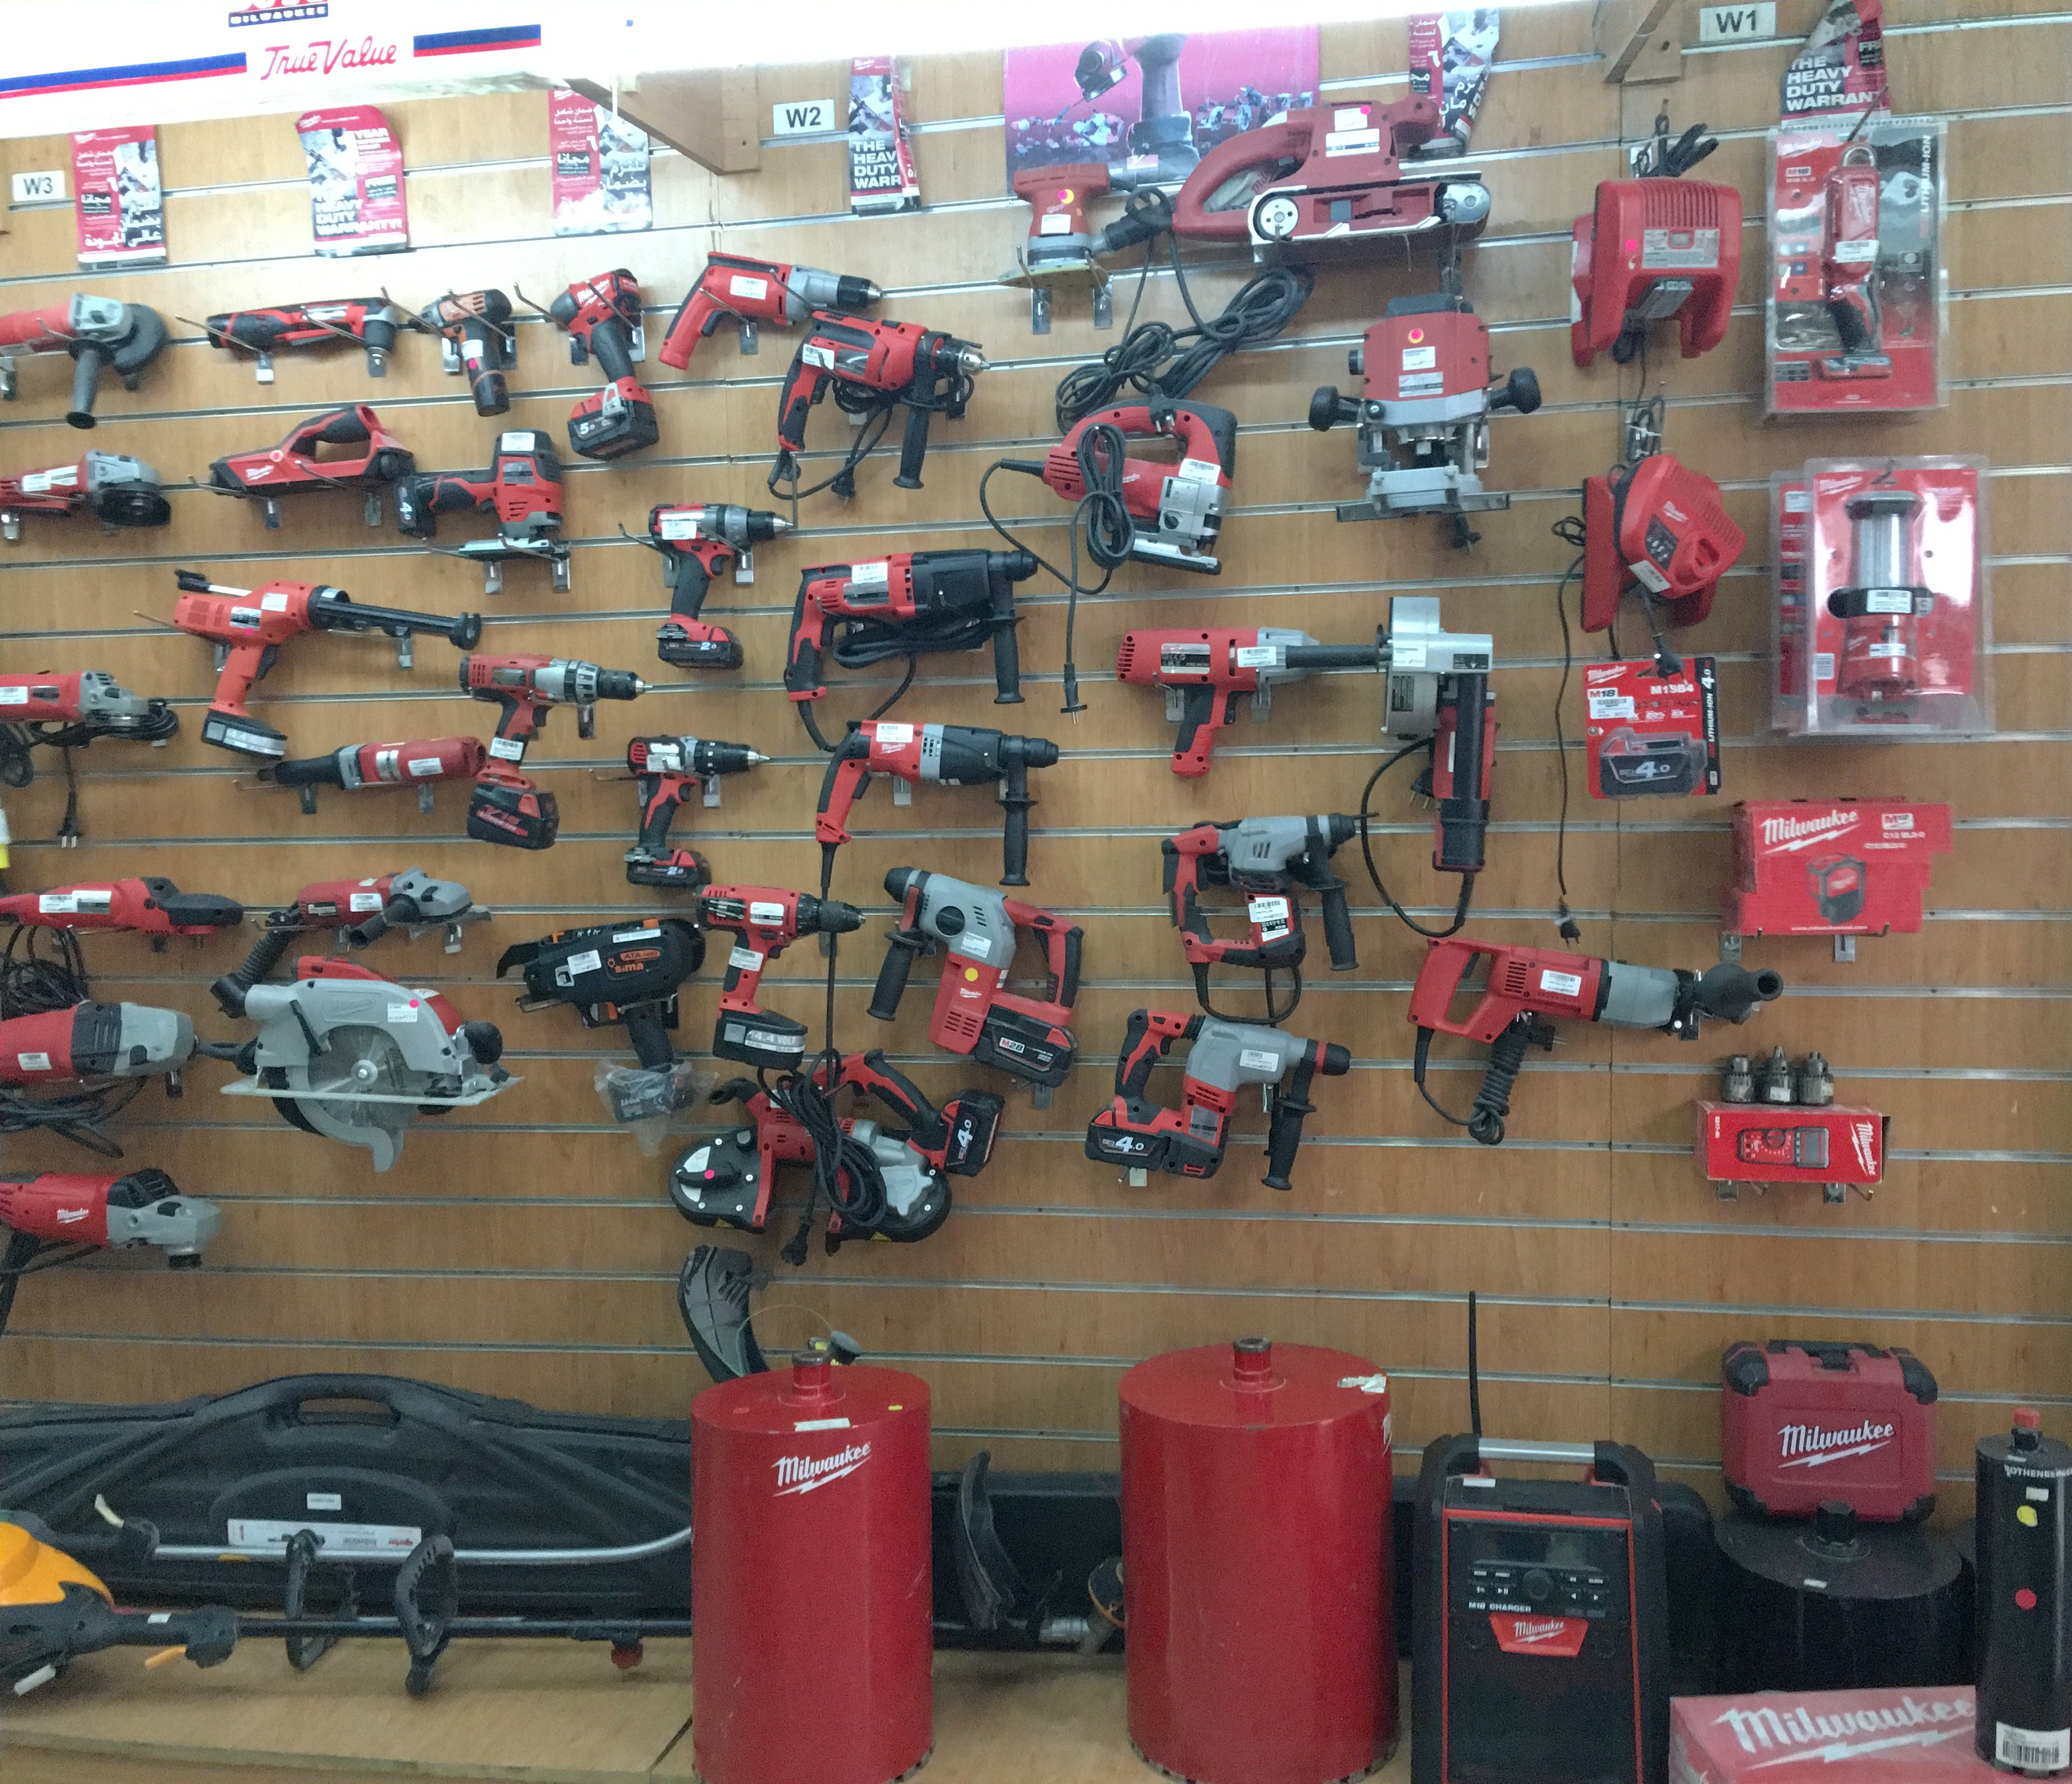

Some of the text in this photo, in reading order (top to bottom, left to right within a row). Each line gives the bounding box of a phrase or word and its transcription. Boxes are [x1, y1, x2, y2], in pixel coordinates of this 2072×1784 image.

[1716, 10, 1757, 33] W1
[260, 35, 396, 80] True Value
[1787, 66, 1852, 84] HEAVY
[1787, 80, 1842, 98] DUTY
[1787, 91, 1881, 111] WARRANT
[785, 106, 821, 128] W2
[853, 140, 886, 152] THE
[853, 151, 897, 164] HEAV
[853, 163, 898, 176] DUTY
[23, 177, 54, 195] W3
[1759, 809, 1860, 846] Milwaukee
[1001, 1039, 1023, 1053] M28
[958, 1120, 973, 1148] 4.0
[1115, 1136, 1144, 1153] 4.0
[1856, 1121, 1876, 1176] Milwaukee
[1777, 1420, 1896, 1458] Milwaukee
[771, 1441, 872, 1487] Milwaukee
[2004, 1464, 2072, 1479] ROTHENBERGE
[1513, 1620, 1565, 1638] Milwaukee
[1713, 1695, 1975, 1754] Milwaukee
